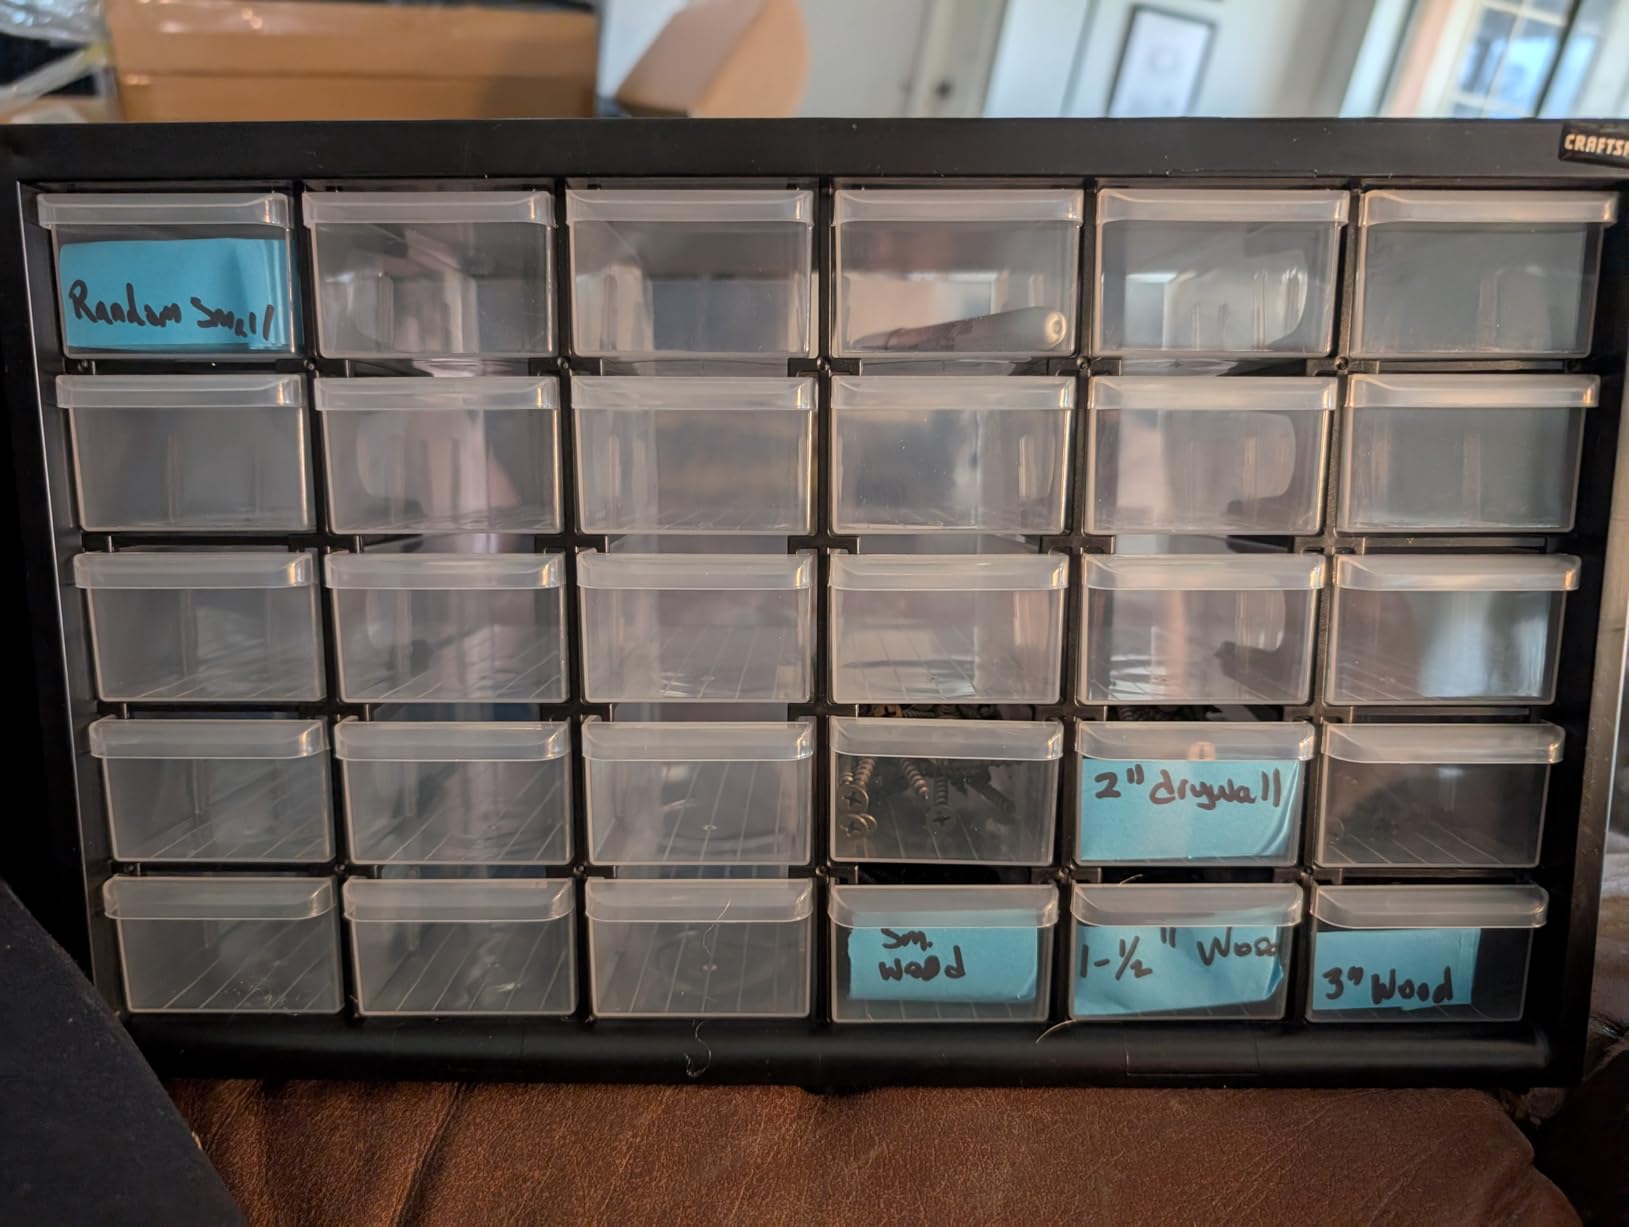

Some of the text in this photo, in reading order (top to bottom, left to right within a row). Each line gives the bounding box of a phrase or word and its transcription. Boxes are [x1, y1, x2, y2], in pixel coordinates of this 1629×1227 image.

[69, 279, 275, 341] Random Small
[1094, 764, 1282, 810] 2" drywall
[1322, 966, 1453, 1005] 3" Wood
